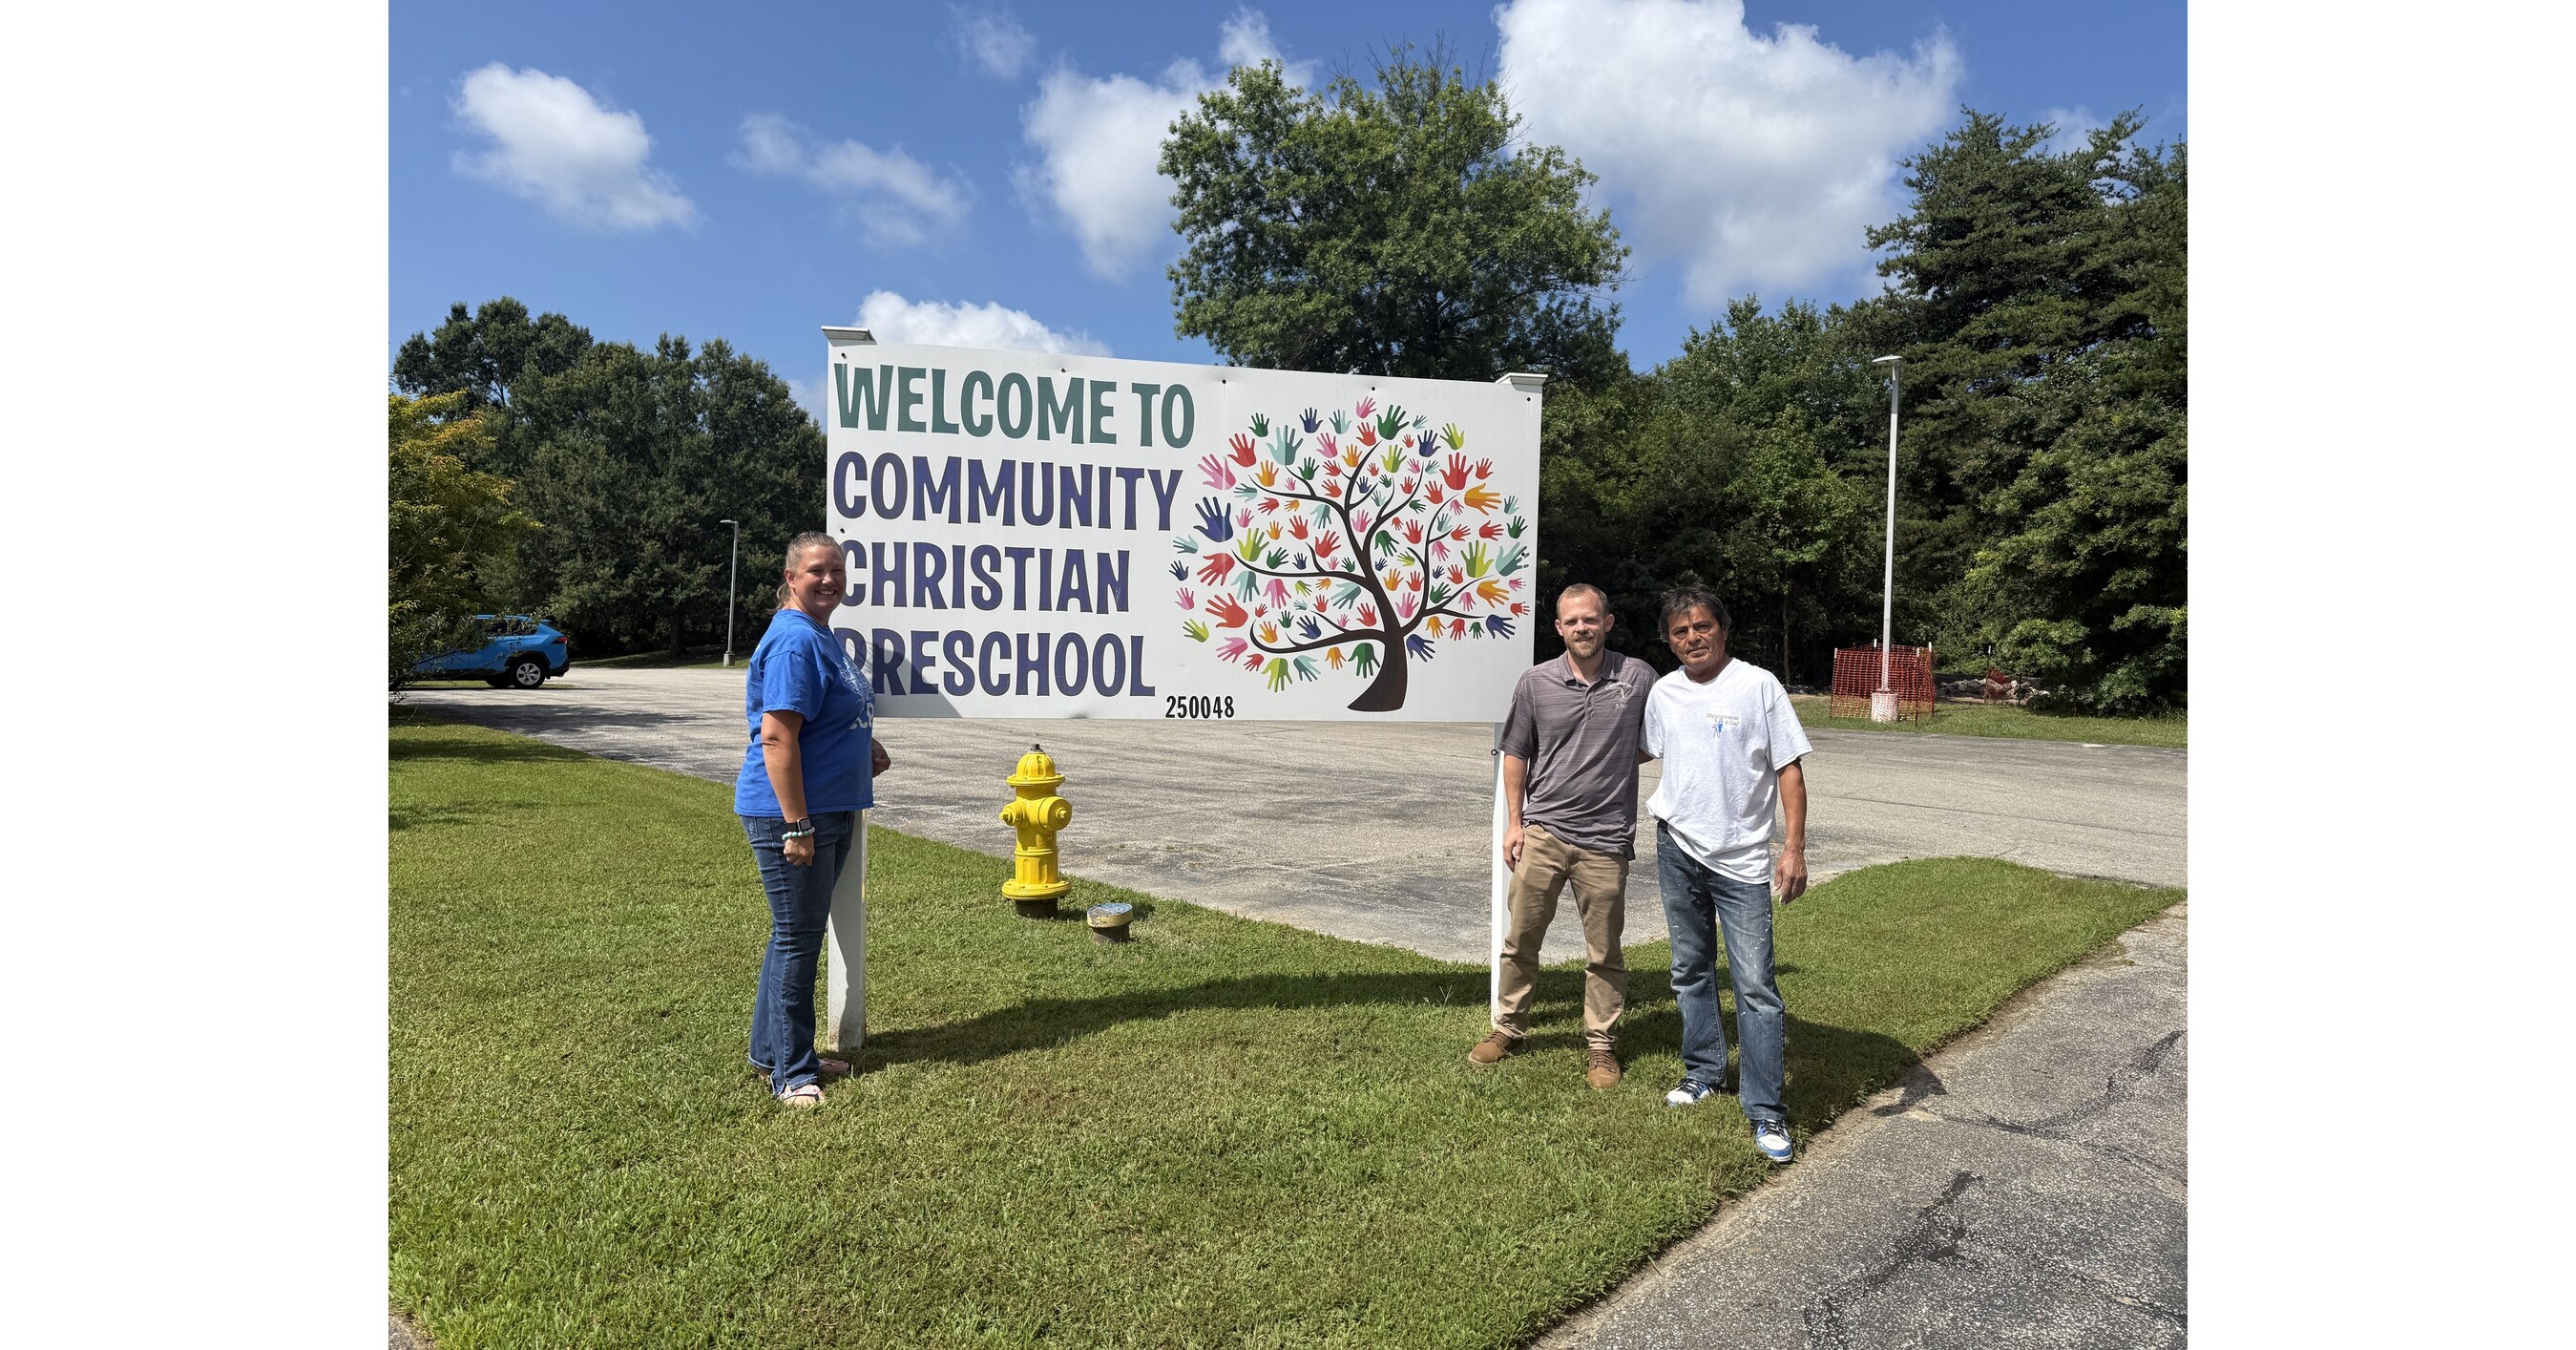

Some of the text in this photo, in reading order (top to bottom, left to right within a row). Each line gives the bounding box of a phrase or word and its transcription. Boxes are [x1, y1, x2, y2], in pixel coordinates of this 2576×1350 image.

[834, 363, 1195, 448] WELCOME TO
[833, 451, 1183, 531] COMMUNITY
[841, 539, 1130, 614] CHRISTIAN
[1165, 695, 1235, 719] 250048
